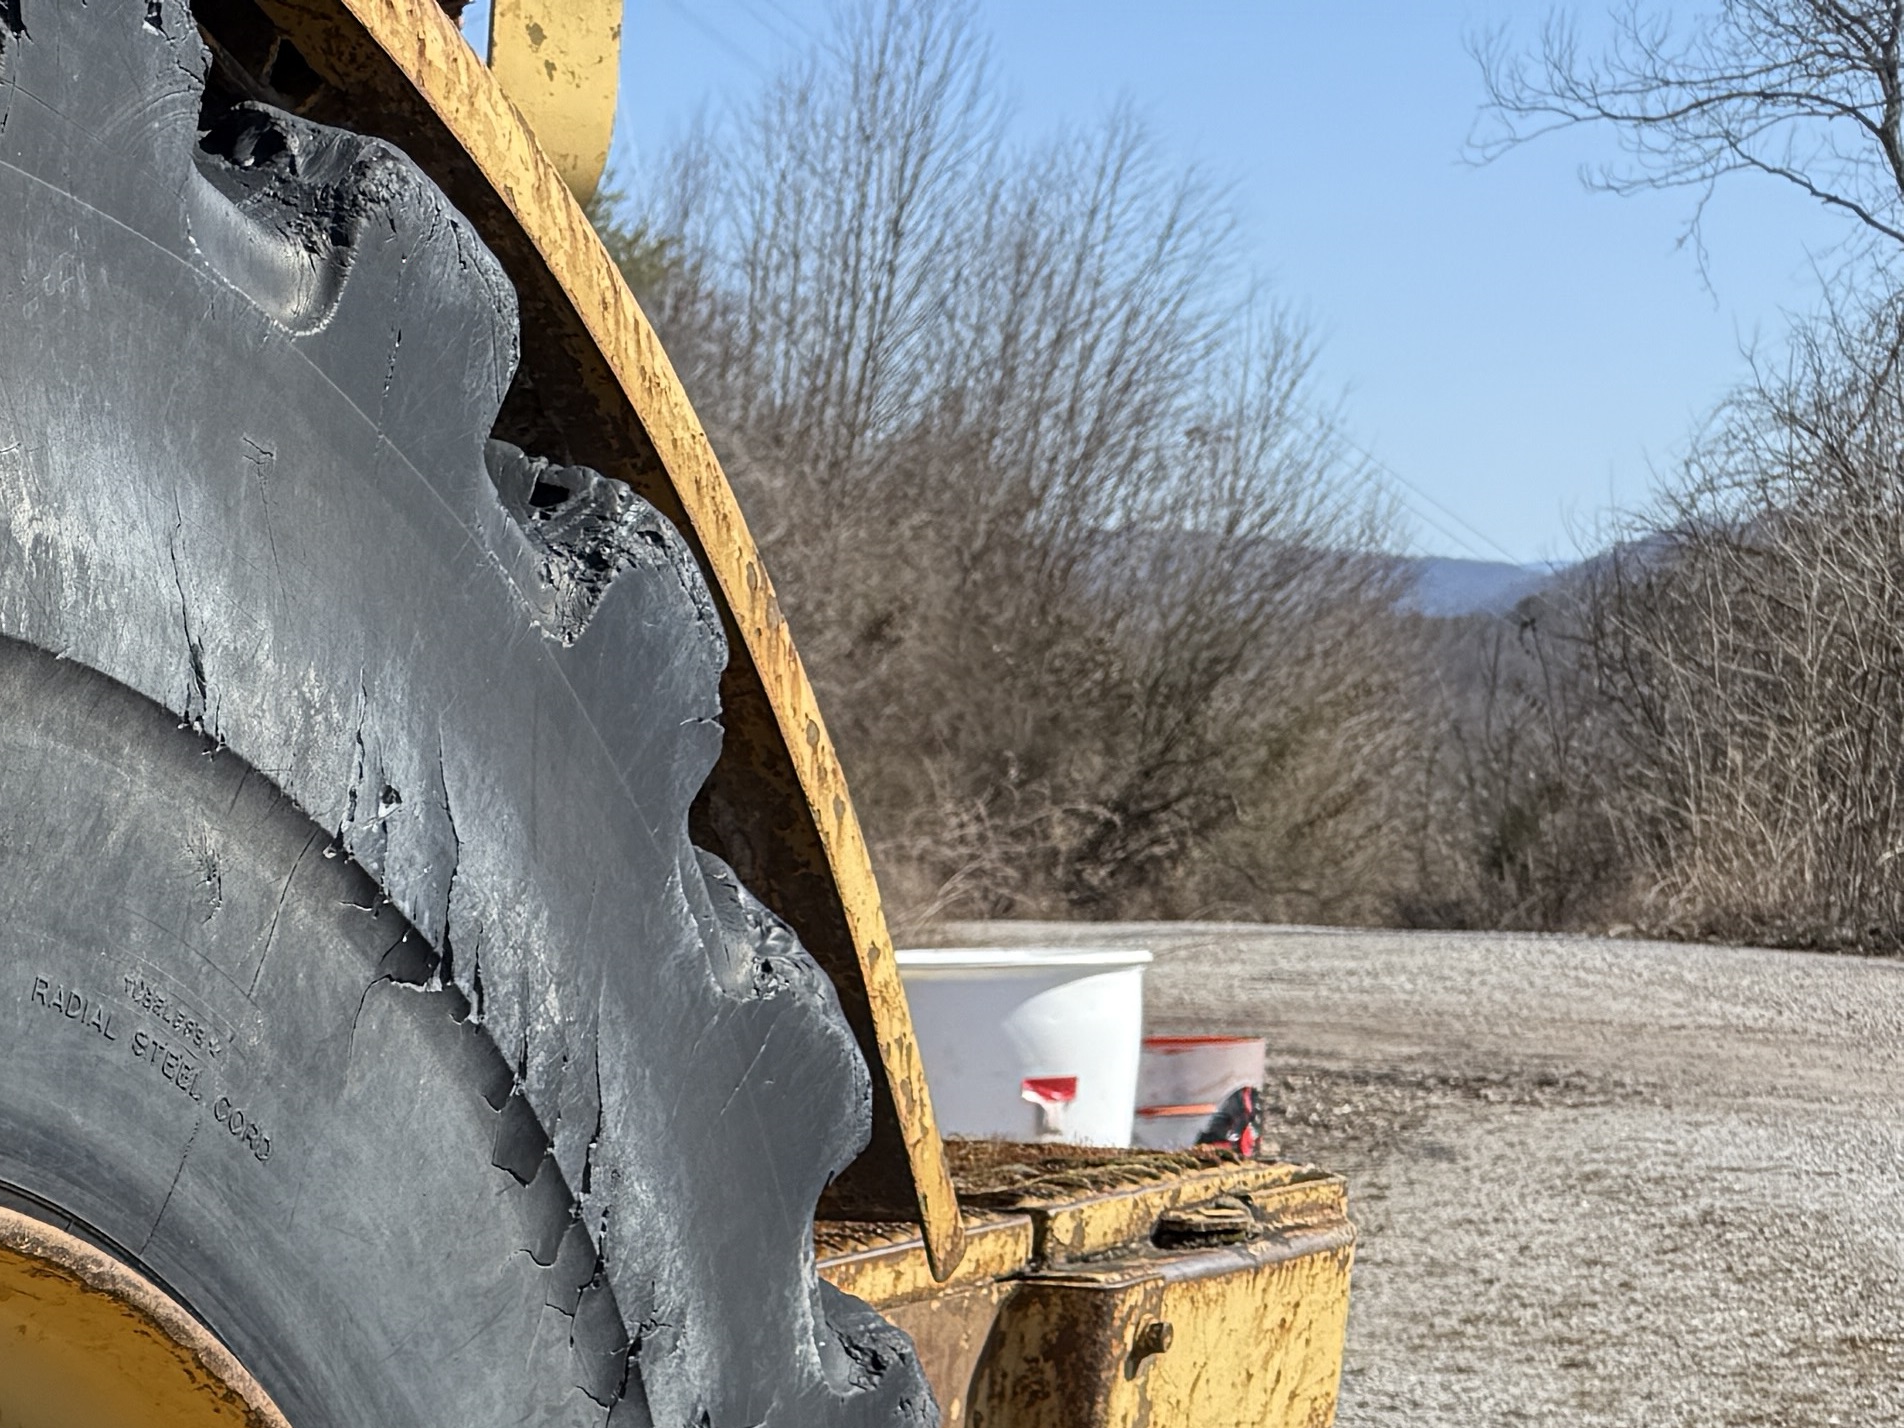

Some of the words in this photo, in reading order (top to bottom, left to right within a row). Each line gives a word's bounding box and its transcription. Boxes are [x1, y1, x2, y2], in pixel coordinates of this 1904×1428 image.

[31, 974, 116, 1042] RADIAL
[131, 1031, 202, 1102] STEEL
[213, 1096, 273, 1163] CORD
